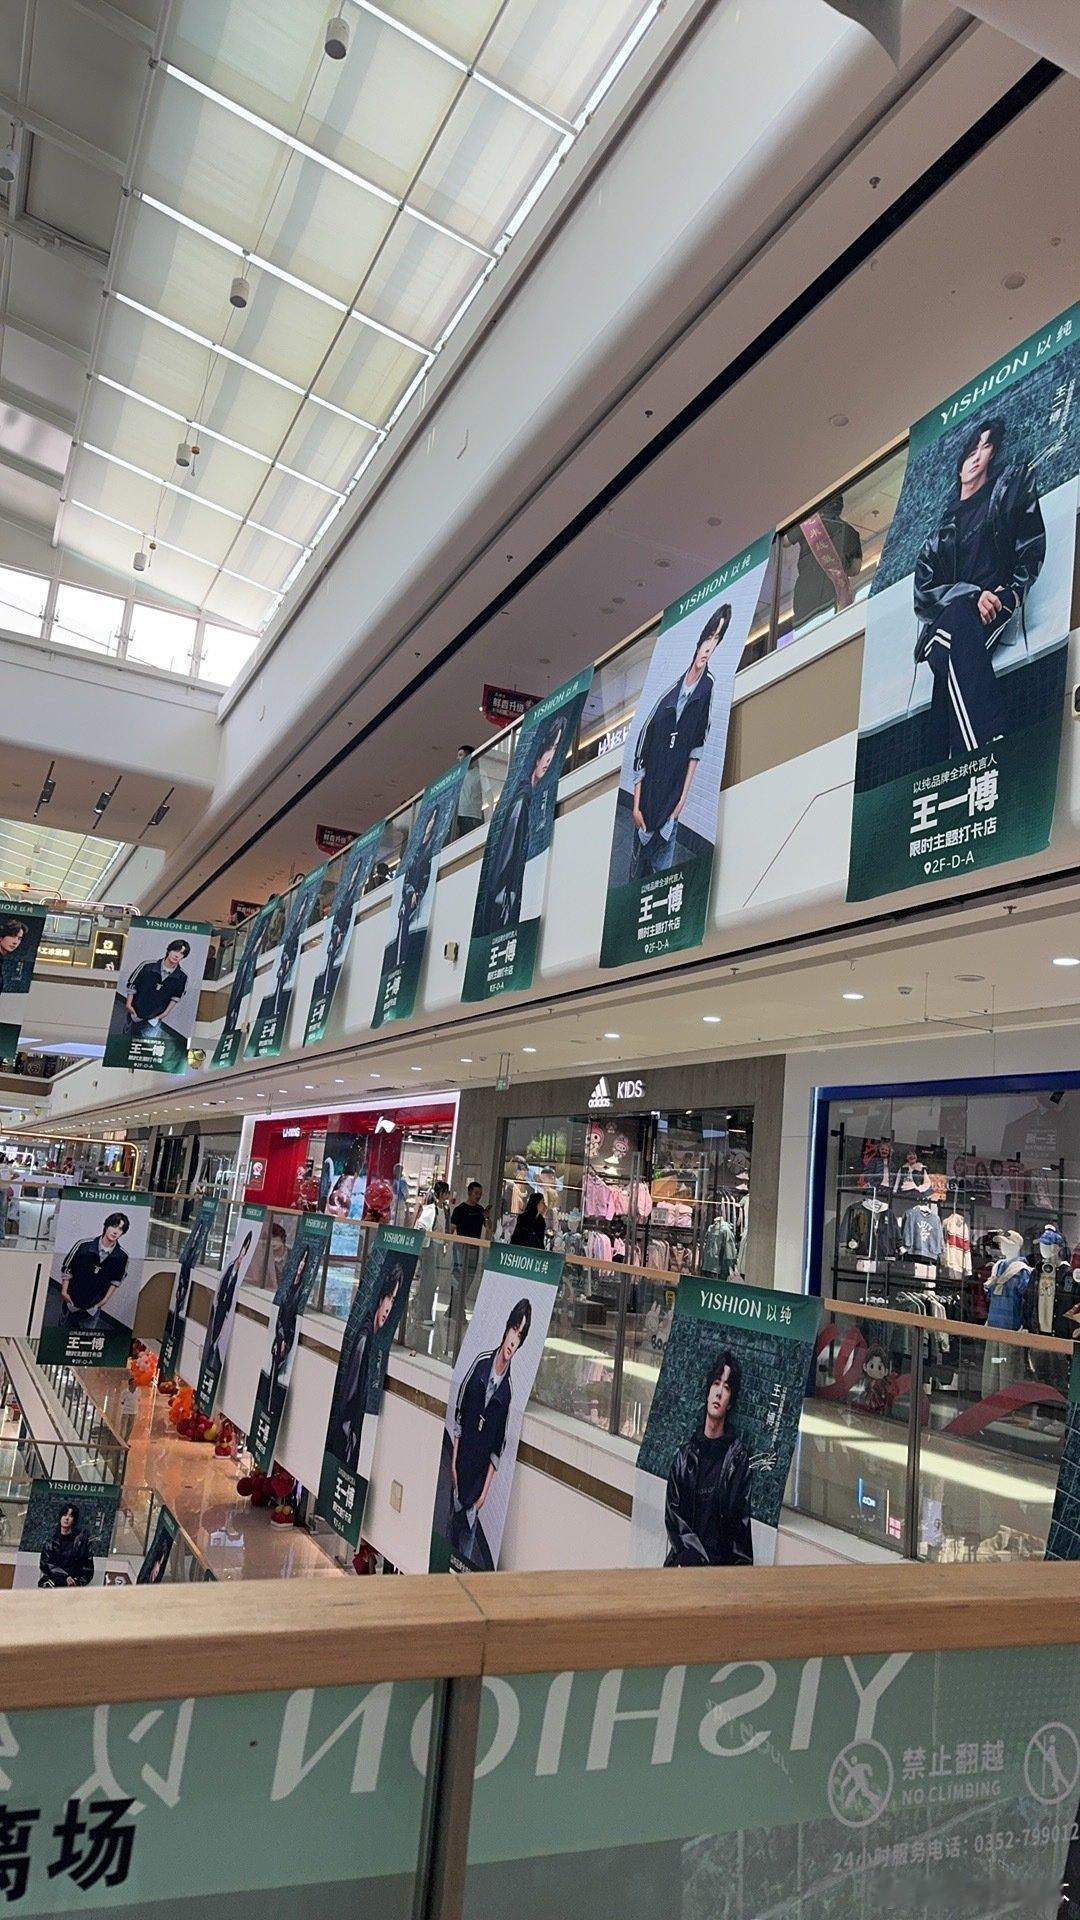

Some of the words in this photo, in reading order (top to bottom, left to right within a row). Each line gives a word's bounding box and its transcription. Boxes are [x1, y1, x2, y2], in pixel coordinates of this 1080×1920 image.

[940, 351, 1028, 424] YISHION
[1036, 319, 1073, 357] 以纯
[679, 571, 728, 615] YISHION
[912, 752, 998, 794] 以纯品牌全球代言人
[910, 769, 999, 834] 王一博
[909, 816, 997, 858] 限时主题打卡店
[931, 850, 975, 874] 2F-D-A
[638, 882, 684, 923] 王一博
[145, 919, 182, 930] YISHION
[488, 938, 517, 968] 王一博
[129, 1043, 165, 1057] 王一博
[617, 1080, 643, 1099] KIDS
[79, 1191, 120, 1201] YISHION
[500, 1252, 534, 1271] YISHION
[700, 1290, 762, 1319] YISHION
[766, 1303, 793, 1326] 以纯
[66, 1336, 106, 1350] 王一博
[49, 1482, 88, 1491] YISHION
[902, 1740, 1005, 1780] 禁止翻越
[902, 1789, 924, 1805] NO
[930, 1781, 1001, 1803] CLIMBING
